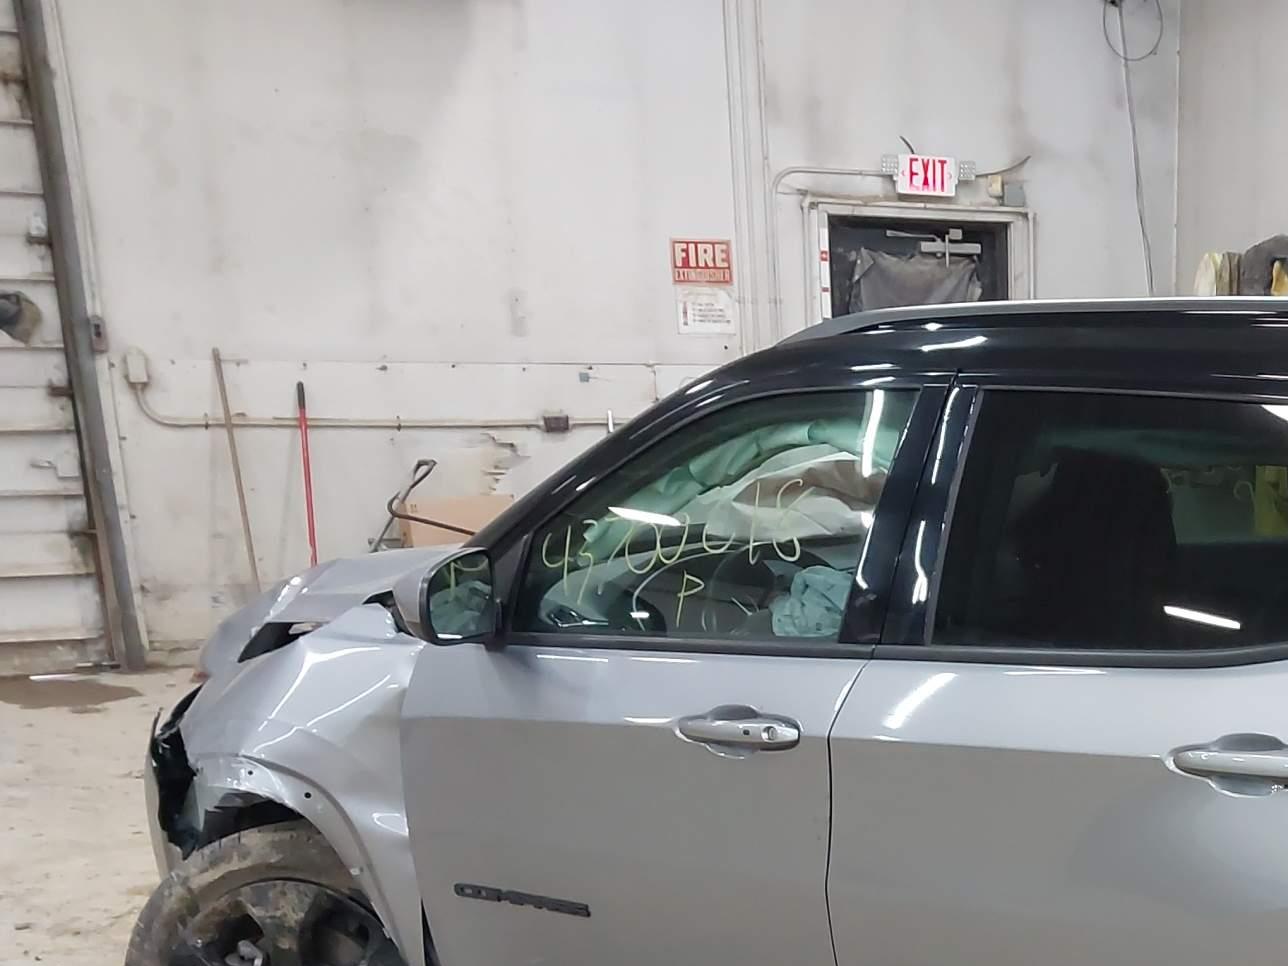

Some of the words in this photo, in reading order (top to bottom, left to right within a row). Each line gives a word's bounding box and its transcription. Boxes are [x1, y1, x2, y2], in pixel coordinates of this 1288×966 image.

[909, 157, 947, 193] EXIT
[673, 242, 730, 268] FIRE
[674, 268, 731, 281] EXTSHER
